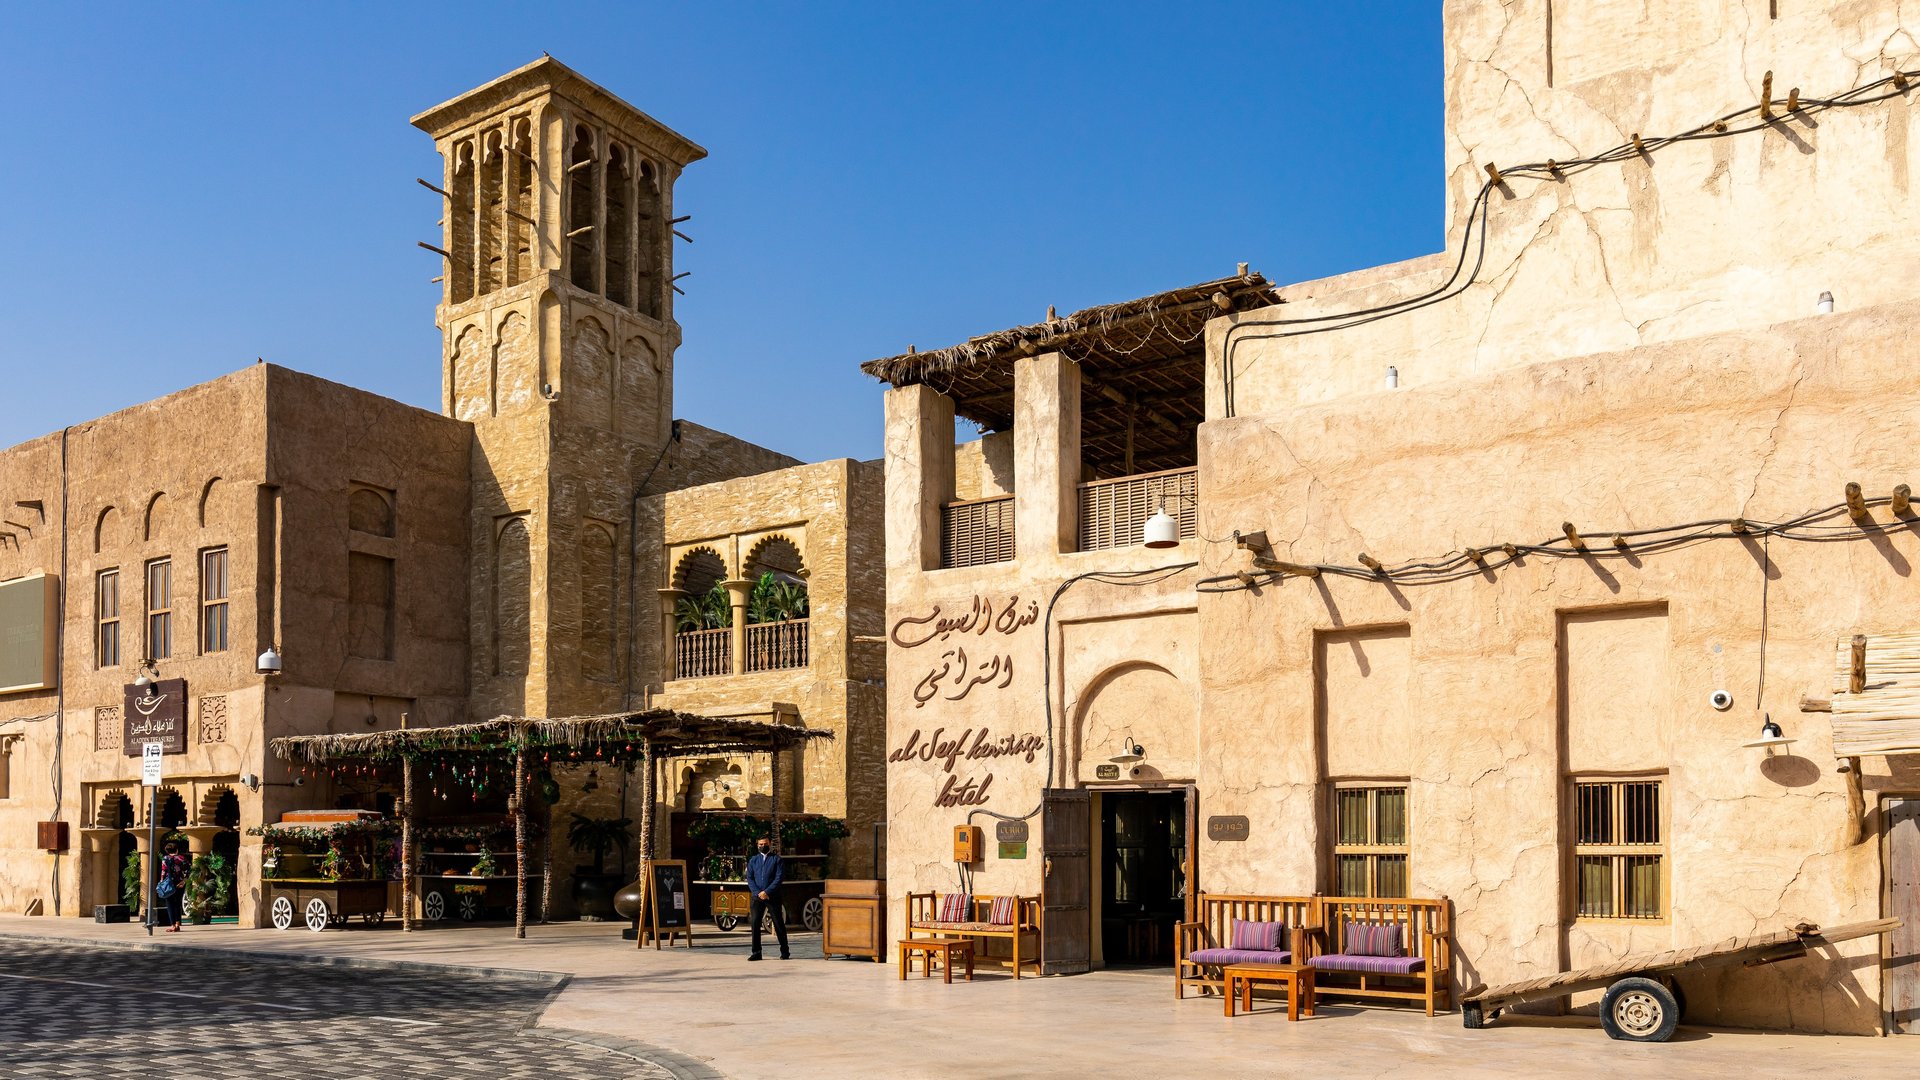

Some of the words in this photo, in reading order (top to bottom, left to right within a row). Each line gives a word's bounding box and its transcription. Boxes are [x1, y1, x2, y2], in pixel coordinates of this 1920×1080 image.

[995, 595, 1039, 635] فندق
[889, 729, 920, 763] al
[919, 728, 972, 773] Seef
[965, 727, 1045, 763] heritage
[934, 773, 993, 808] hotel
